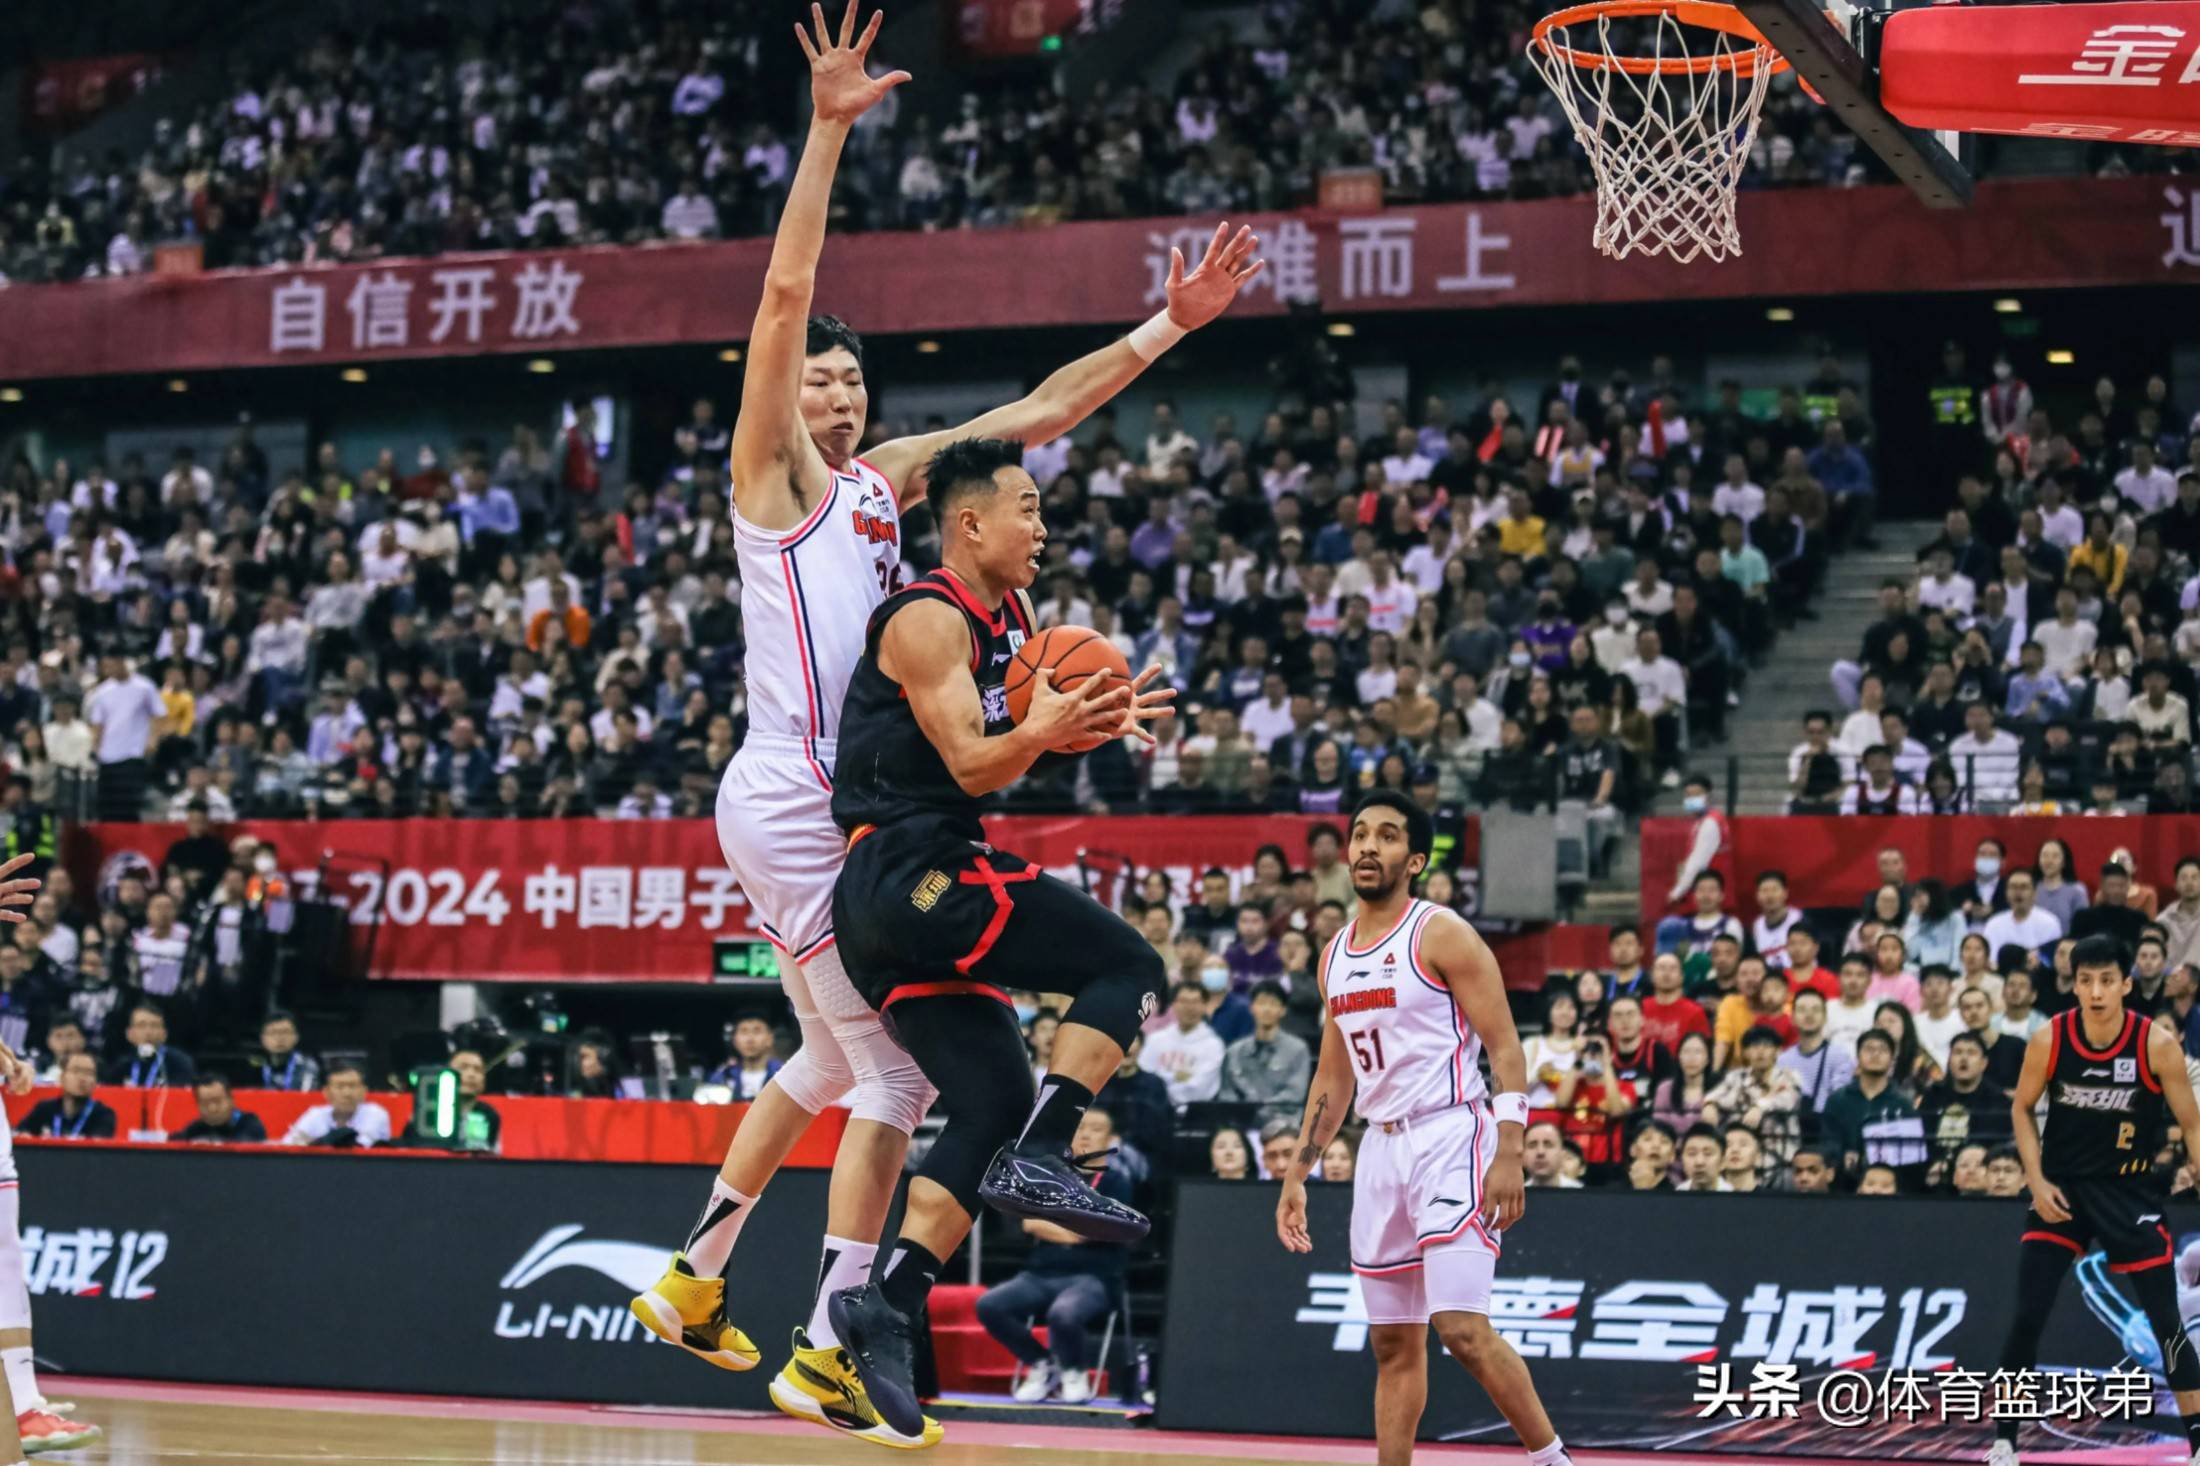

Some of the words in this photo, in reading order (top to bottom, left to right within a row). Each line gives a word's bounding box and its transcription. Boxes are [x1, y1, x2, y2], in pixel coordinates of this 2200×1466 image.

[2017, 24, 2200, 86] 金
[270, 260, 584, 352] 自信开放
[523, 862, 766, 930] 中国男子
[1350, 1028, 1385, 1073] 51
[2116, 1122, 2135, 1149] 2
